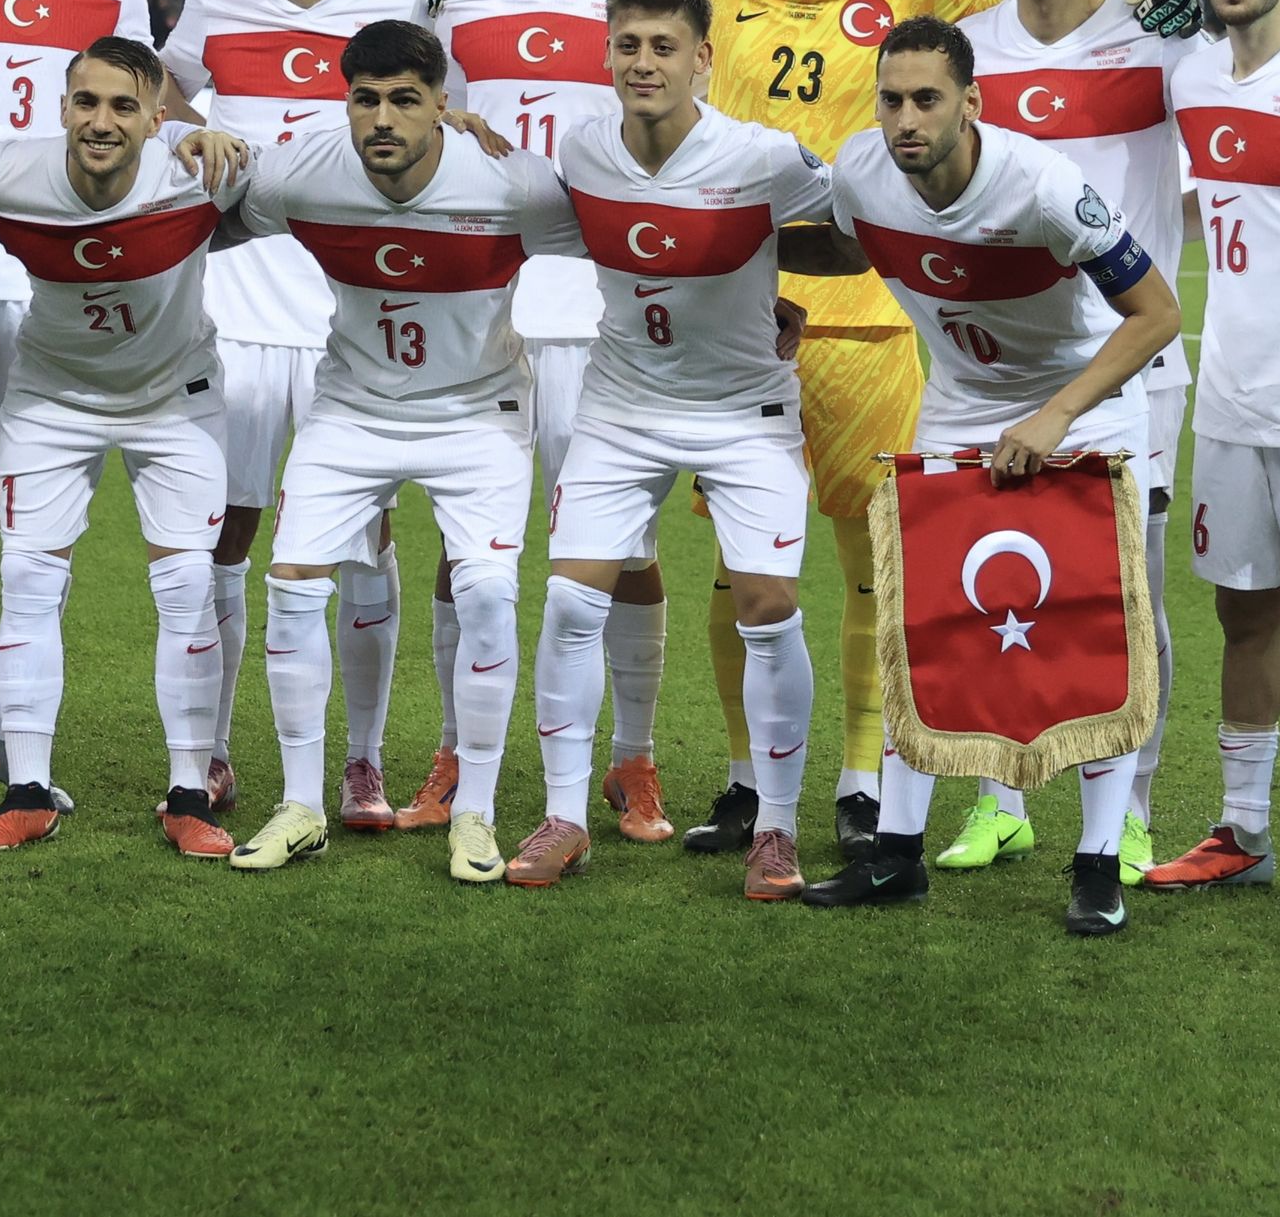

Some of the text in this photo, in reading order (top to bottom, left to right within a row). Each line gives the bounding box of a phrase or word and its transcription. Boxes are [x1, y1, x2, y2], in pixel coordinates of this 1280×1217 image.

[768, 46, 825, 104] 23
[10, 76, 36, 130] 3
[515, 113, 557, 159] 11
[1209, 216, 1249, 273] 16
[83, 303, 137, 334] 21
[377, 318, 427, 369] 13
[644, 304, 674, 346] 8
[942, 321, 1002, 365] 10
[1193, 503, 1210, 558] 6
